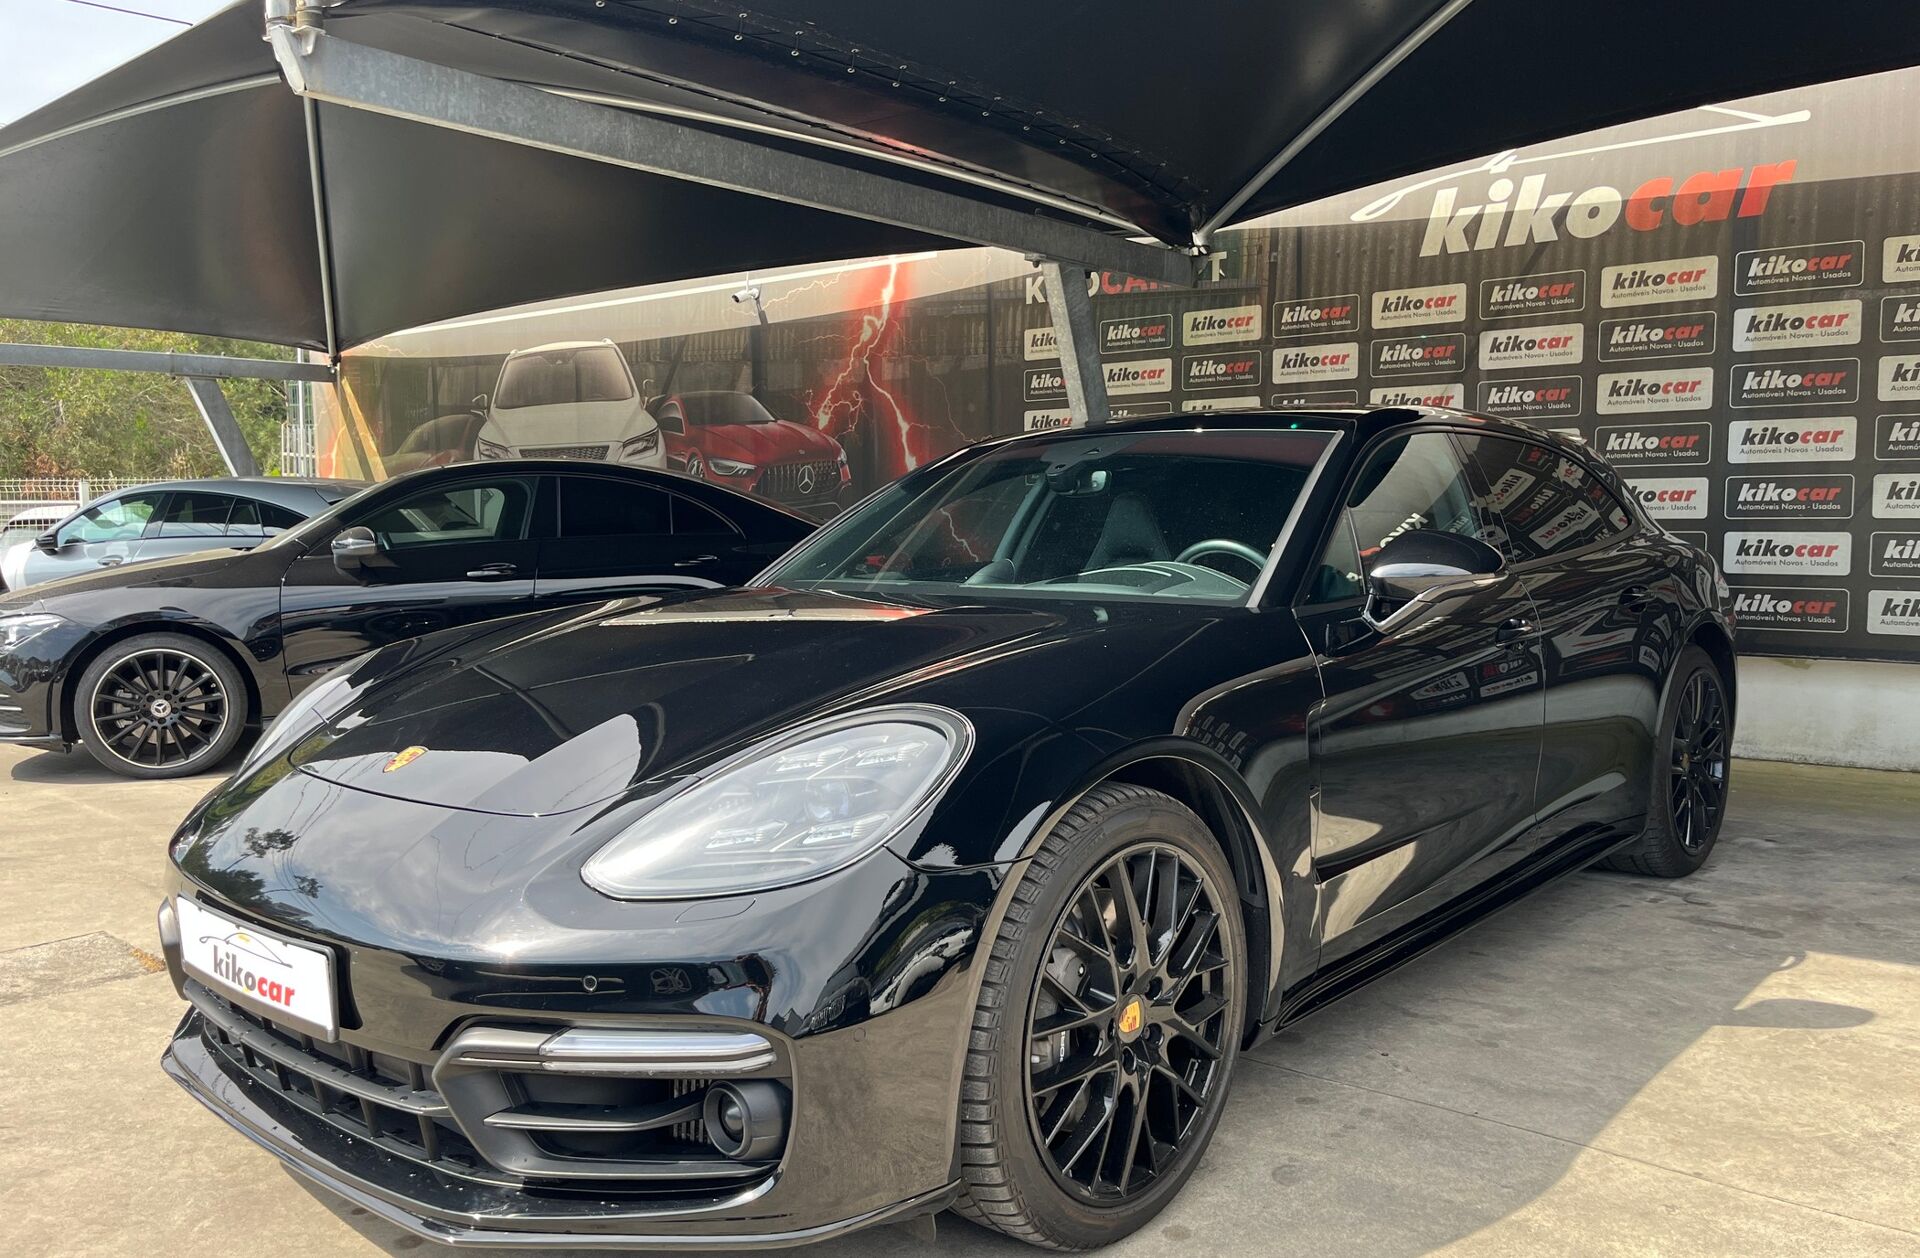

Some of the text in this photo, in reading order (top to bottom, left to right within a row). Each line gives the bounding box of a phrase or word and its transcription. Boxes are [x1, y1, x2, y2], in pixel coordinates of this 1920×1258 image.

[1419, 160, 1798, 257] kikocar
[1748, 253, 1852, 277] kikocar
[1612, 268, 1707, 290] kikocar
[1747, 275, 1789, 286] Automóveis
[1792, 273, 1815, 282] Novos
[1823, 270, 1851, 279] Usados
[1490, 282, 1575, 302] kikocar
[1381, 294, 1457, 313] kikocar
[1190, 314, 1254, 331] kikocar
[1281, 304, 1351, 323] kikocar
[1746, 312, 1849, 333] kikocar
[1107, 324, 1165, 340] kikocar
[1610, 323, 1704, 344] kikocar
[1744, 332, 1786, 342] Automóveis
[1789, 331, 1813, 339] Novos
[1821, 329, 1849, 337] Usados
[1379, 343, 1456, 362] kikocar
[1489, 334, 1573, 353] kikocar
[1609, 342, 1647, 352] Automóveis
[1650, 341, 1671, 349] Novos
[1678, 339, 1704, 348] Usados
[1190, 359, 1254, 375] kikocar
[1281, 352, 1349, 369] kikocar
[1107, 366, 1165, 382] kikocar
[1742, 370, 1847, 390] kikocar
[1891, 362, 1920, 382] ki
[1487, 386, 1571, 403] kikocar
[1608, 379, 1701, 398] kikocar
[1742, 390, 1784, 399] Automóveis
[1787, 389, 1811, 397] Novos
[1818, 387, 1847, 395] Usados
[1606, 432, 1699, 450] kikocar
[1741, 427, 1844, 445] kikocar
[1740, 446, 1781, 455] Automóveis
[1737, 483, 1841, 501] kikocar
[1736, 539, 1839, 557] kikocar
[1735, 594, 1836, 614] kikocar
[213, 944, 295, 1007] kikocar
